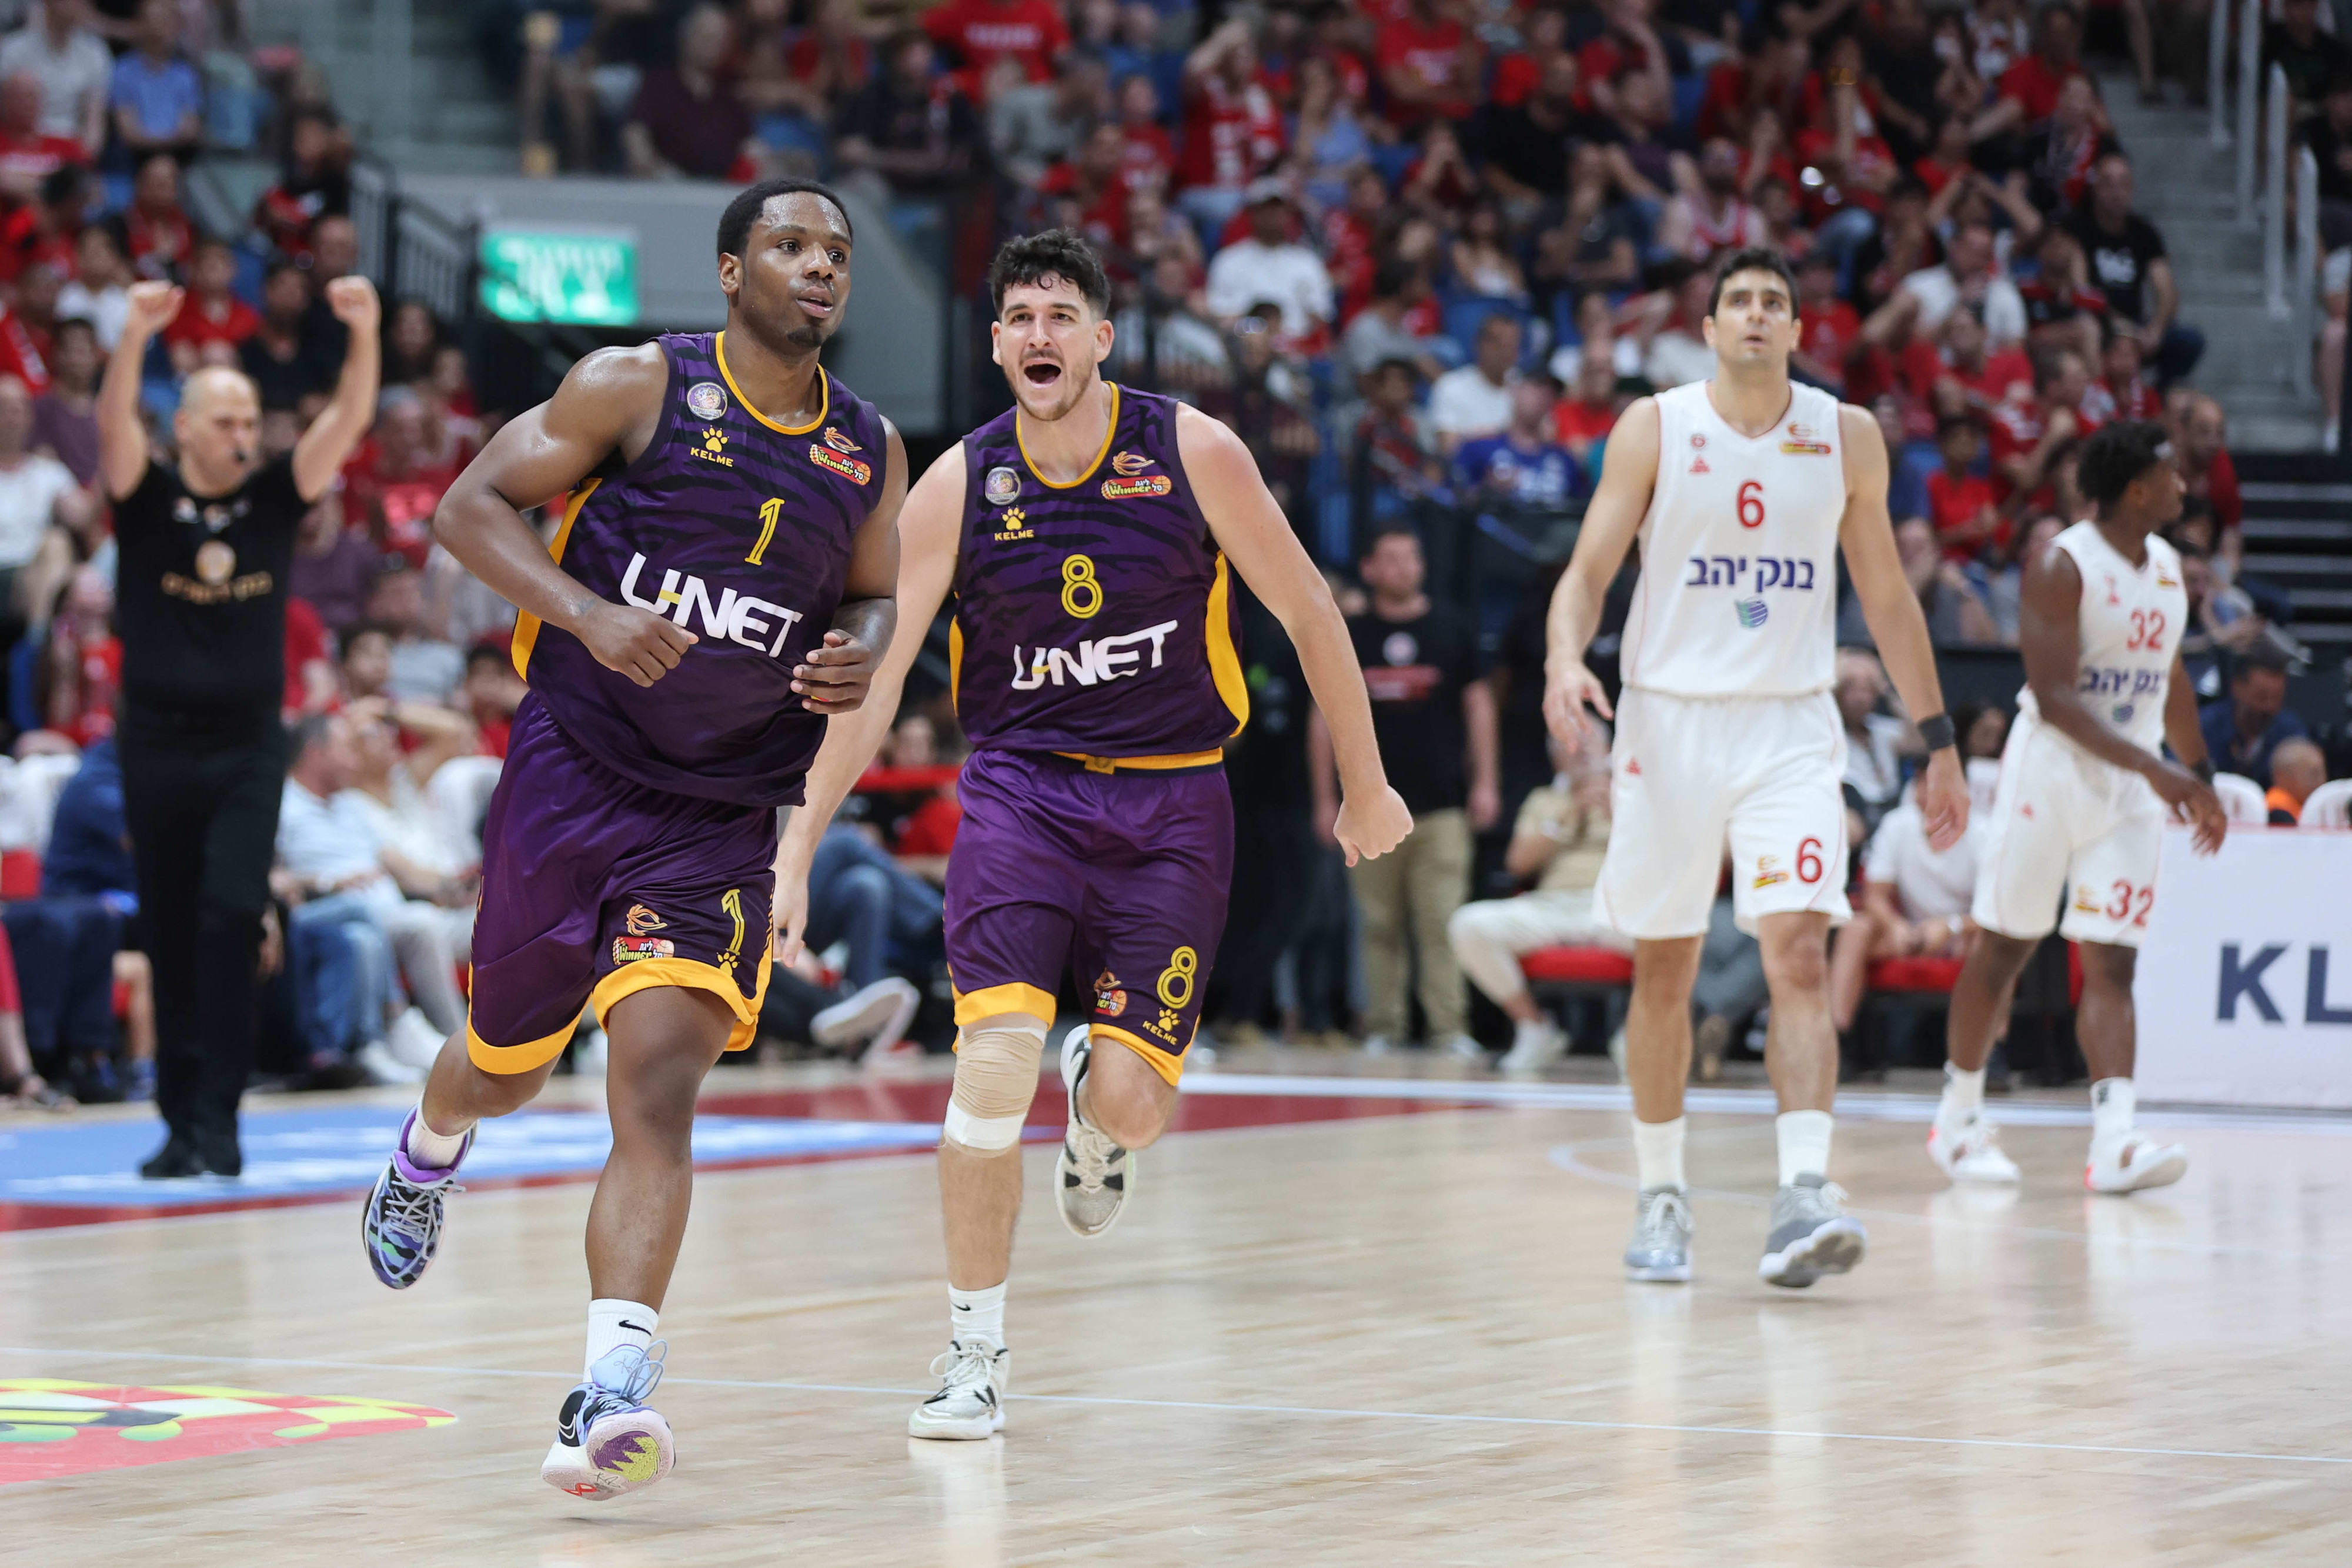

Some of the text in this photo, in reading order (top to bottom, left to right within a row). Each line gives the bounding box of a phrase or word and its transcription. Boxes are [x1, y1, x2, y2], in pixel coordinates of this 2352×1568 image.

[690, 447, 733, 467] KELME
[818, 450, 854, 475] Winner
[1109, 484, 1151, 496] Winner
[1736, 481, 1764, 529] 6
[744, 497, 785, 566] 1
[994, 529, 1035, 541] KELME
[1061, 554, 1103, 619] 8
[1686, 556, 1815, 593] בנק יהב
[620, 551, 803, 657] UNET
[2127, 609, 2166, 650] 32
[1011, 620, 1178, 690] UNET
[1796, 837, 1823, 883] 6
[721, 888, 744, 955] 1
[2106, 879, 2153, 927] 32
[619, 944, 652, 961] Winner
[1157, 945, 1198, 1009] 8
[1142, 1020, 1178, 1046] KELME
